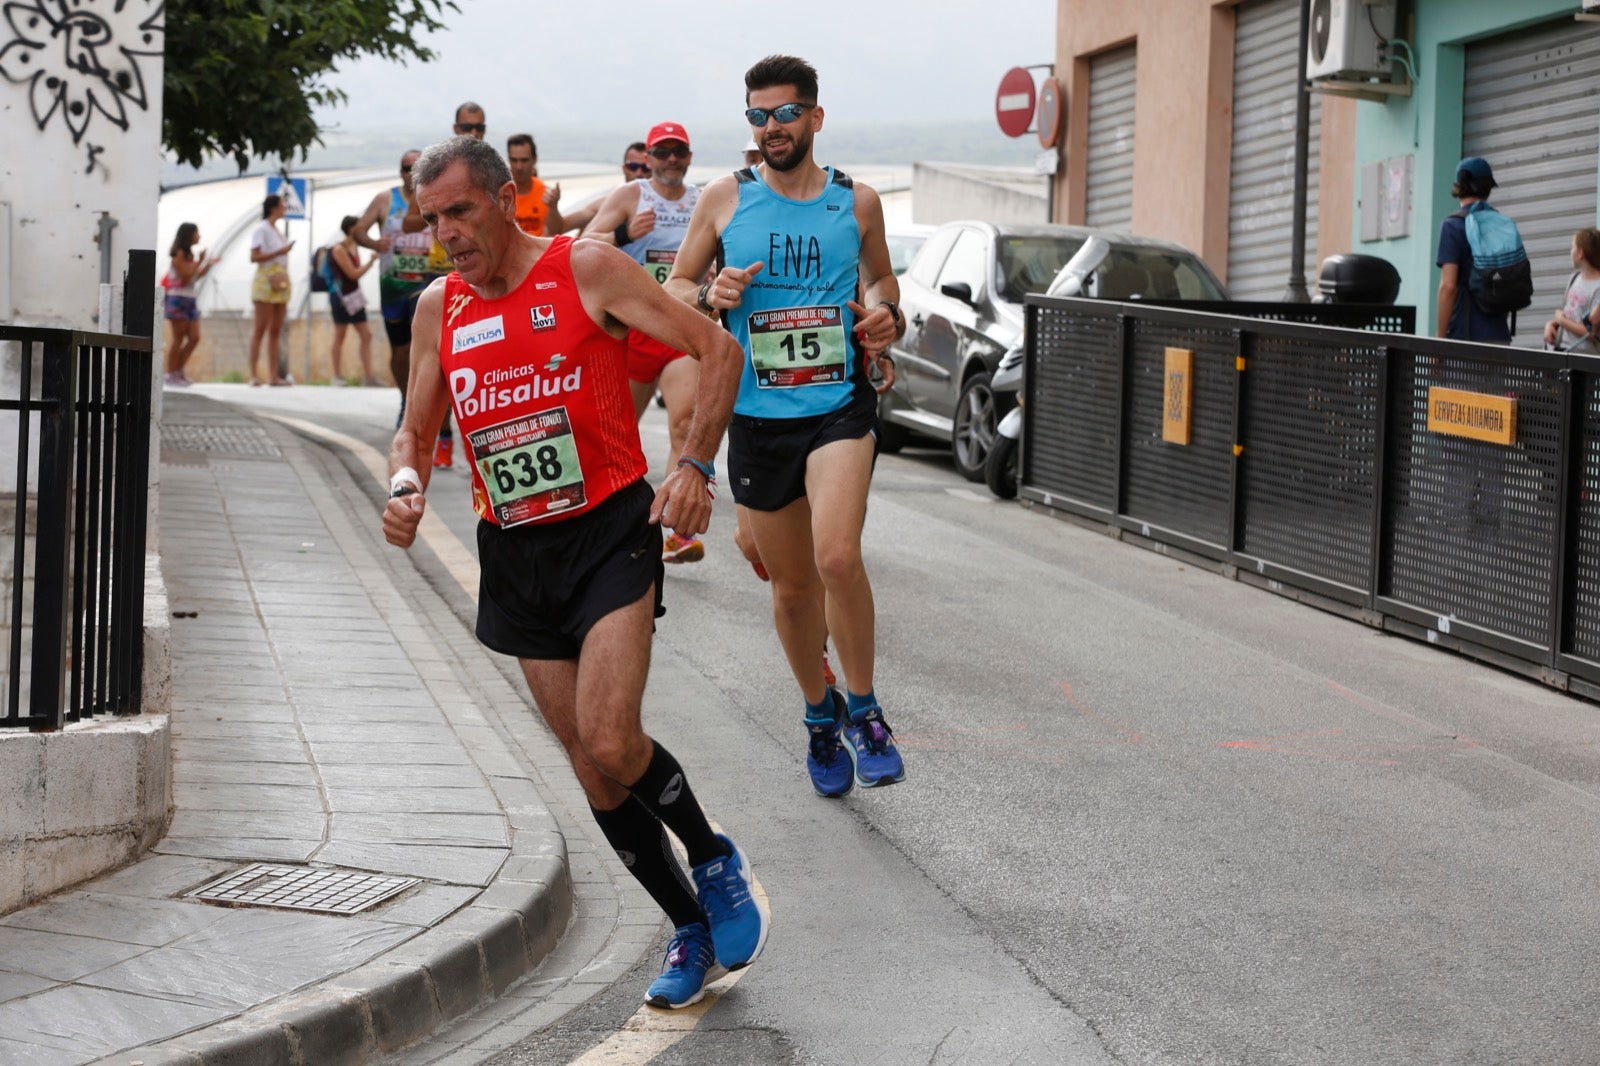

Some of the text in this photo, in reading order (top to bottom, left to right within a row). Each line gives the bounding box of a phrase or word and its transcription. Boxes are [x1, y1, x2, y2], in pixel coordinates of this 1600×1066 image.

[399, 257, 426, 270] 905
[768, 232, 821, 279] ENA
[532, 308, 538, 321] I
[533, 318, 555, 328] MOVE
[769, 311, 786, 322] GRAN
[786, 309, 809, 321] PREMIO
[809, 309, 817, 318] DE
[817, 308, 836, 319] FONO
[780, 332, 821, 361] 15
[483, 363, 535, 385] Clínicas
[449, 366, 582, 420] Polisalud
[486, 428, 504, 443] GRAN
[504, 421, 530, 438] PREMIO
[530, 418, 539, 431] DE
[539, 412, 562, 428] FONDO
[1434, 399, 1504, 433] CERVEZAS ALHAMBRA
[493, 445, 563, 494] 638
